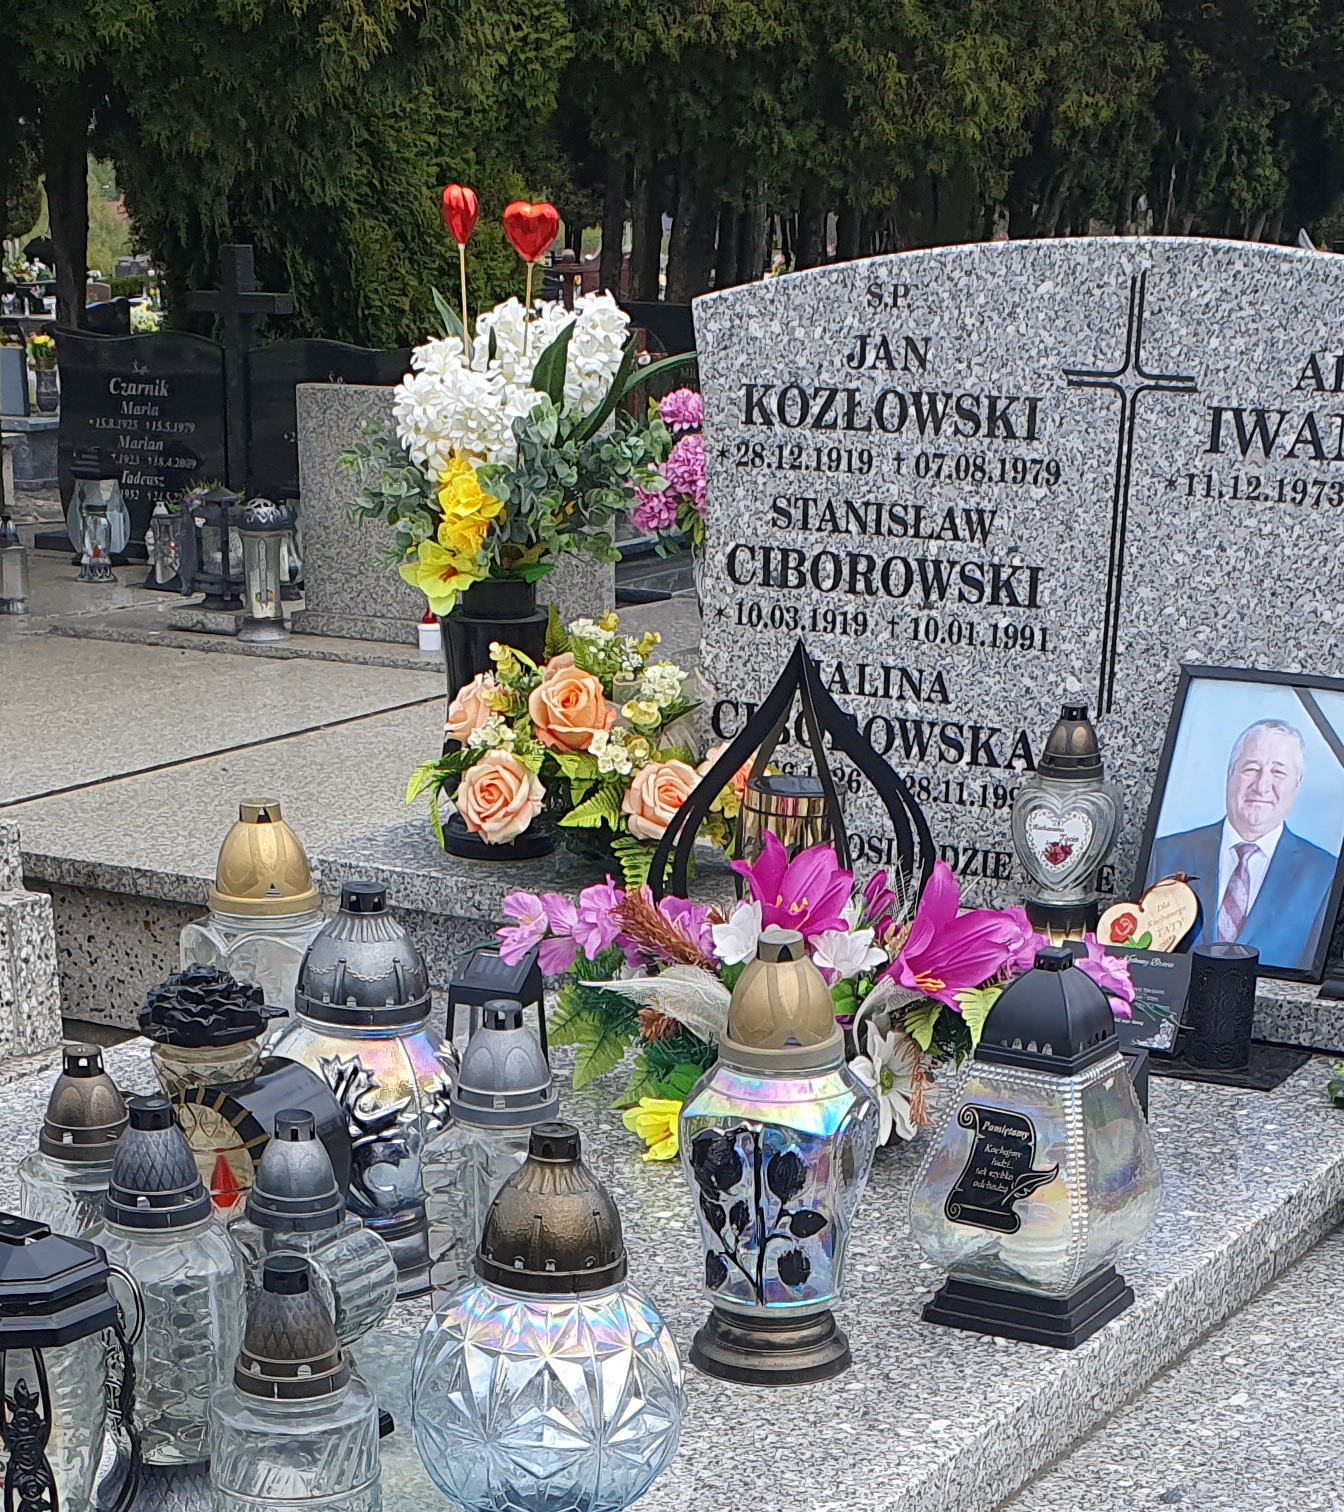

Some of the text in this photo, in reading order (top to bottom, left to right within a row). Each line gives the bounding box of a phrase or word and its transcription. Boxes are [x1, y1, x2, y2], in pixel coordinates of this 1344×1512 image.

[845, 333, 932, 372] JAN
[109, 376, 170, 398] Czarnik
[120, 400, 160, 417] Maria
[740, 382, 1046, 441] KOZŁOWSKI
[117, 434, 165, 452] Marian
[121, 467, 167, 488] Tadeusz
[770, 495, 998, 547] STANISŁAW
[725, 543, 1045, 610] CIBOROWSKI
[981, 1120, 1031, 1141] Pamiętamy
